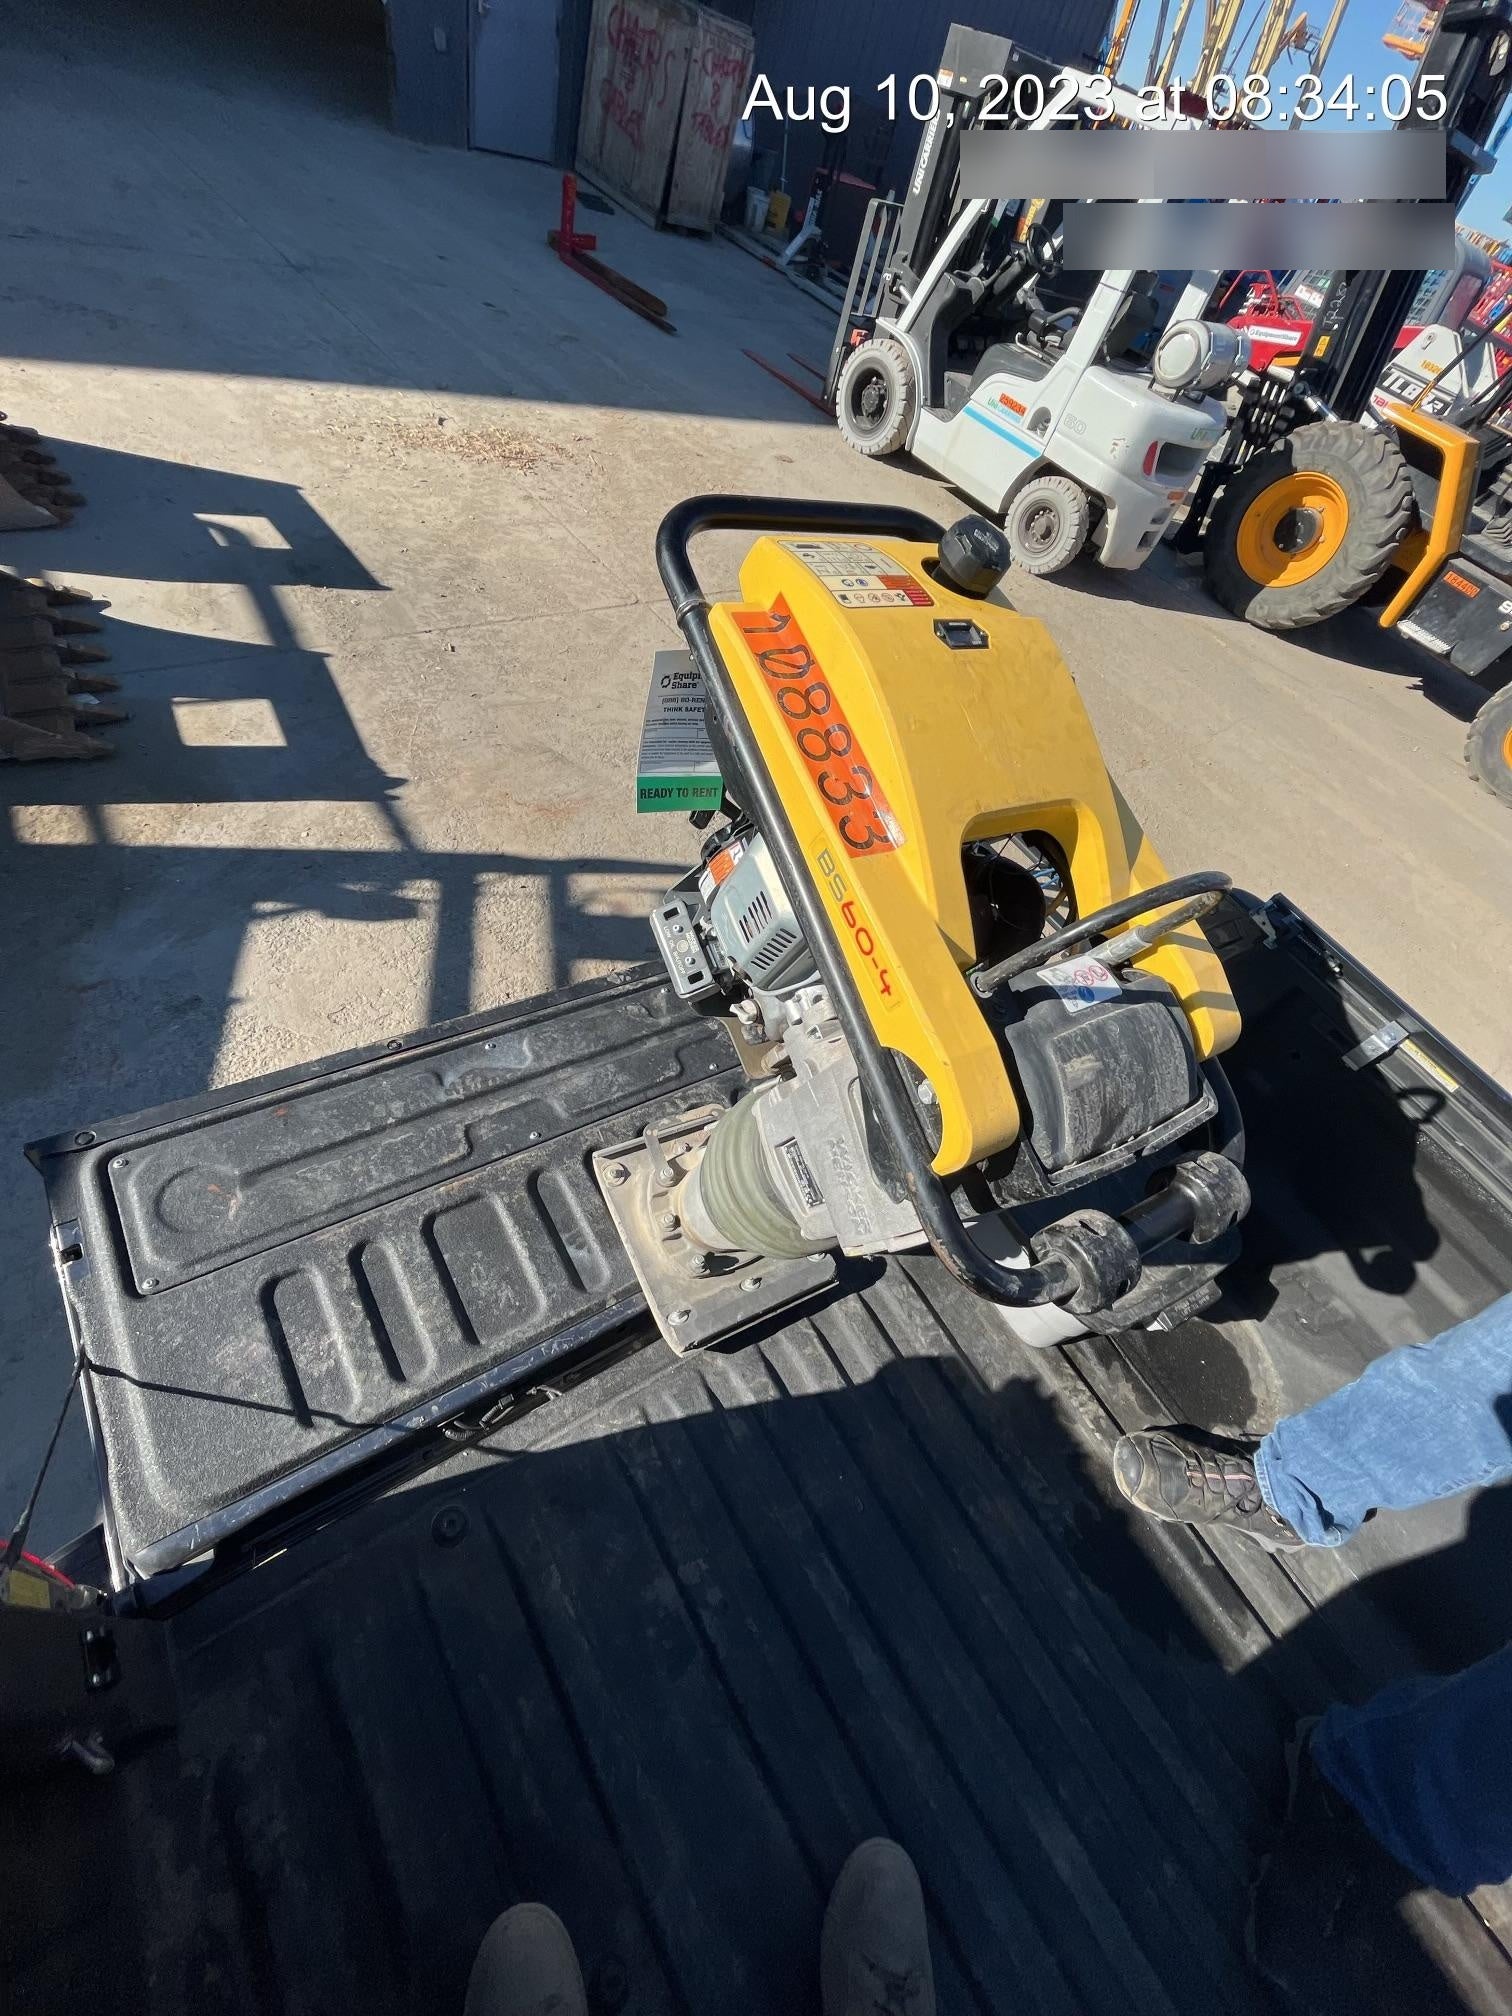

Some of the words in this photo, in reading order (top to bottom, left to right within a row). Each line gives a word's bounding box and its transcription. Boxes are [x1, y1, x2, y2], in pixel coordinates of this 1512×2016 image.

[671, 681, 698, 689] Share
[640, 788, 674, 799] READY
[676, 787, 689, 798] TO
[693, 786, 719, 798] RENT
[663, 926, 672, 938] LOW
